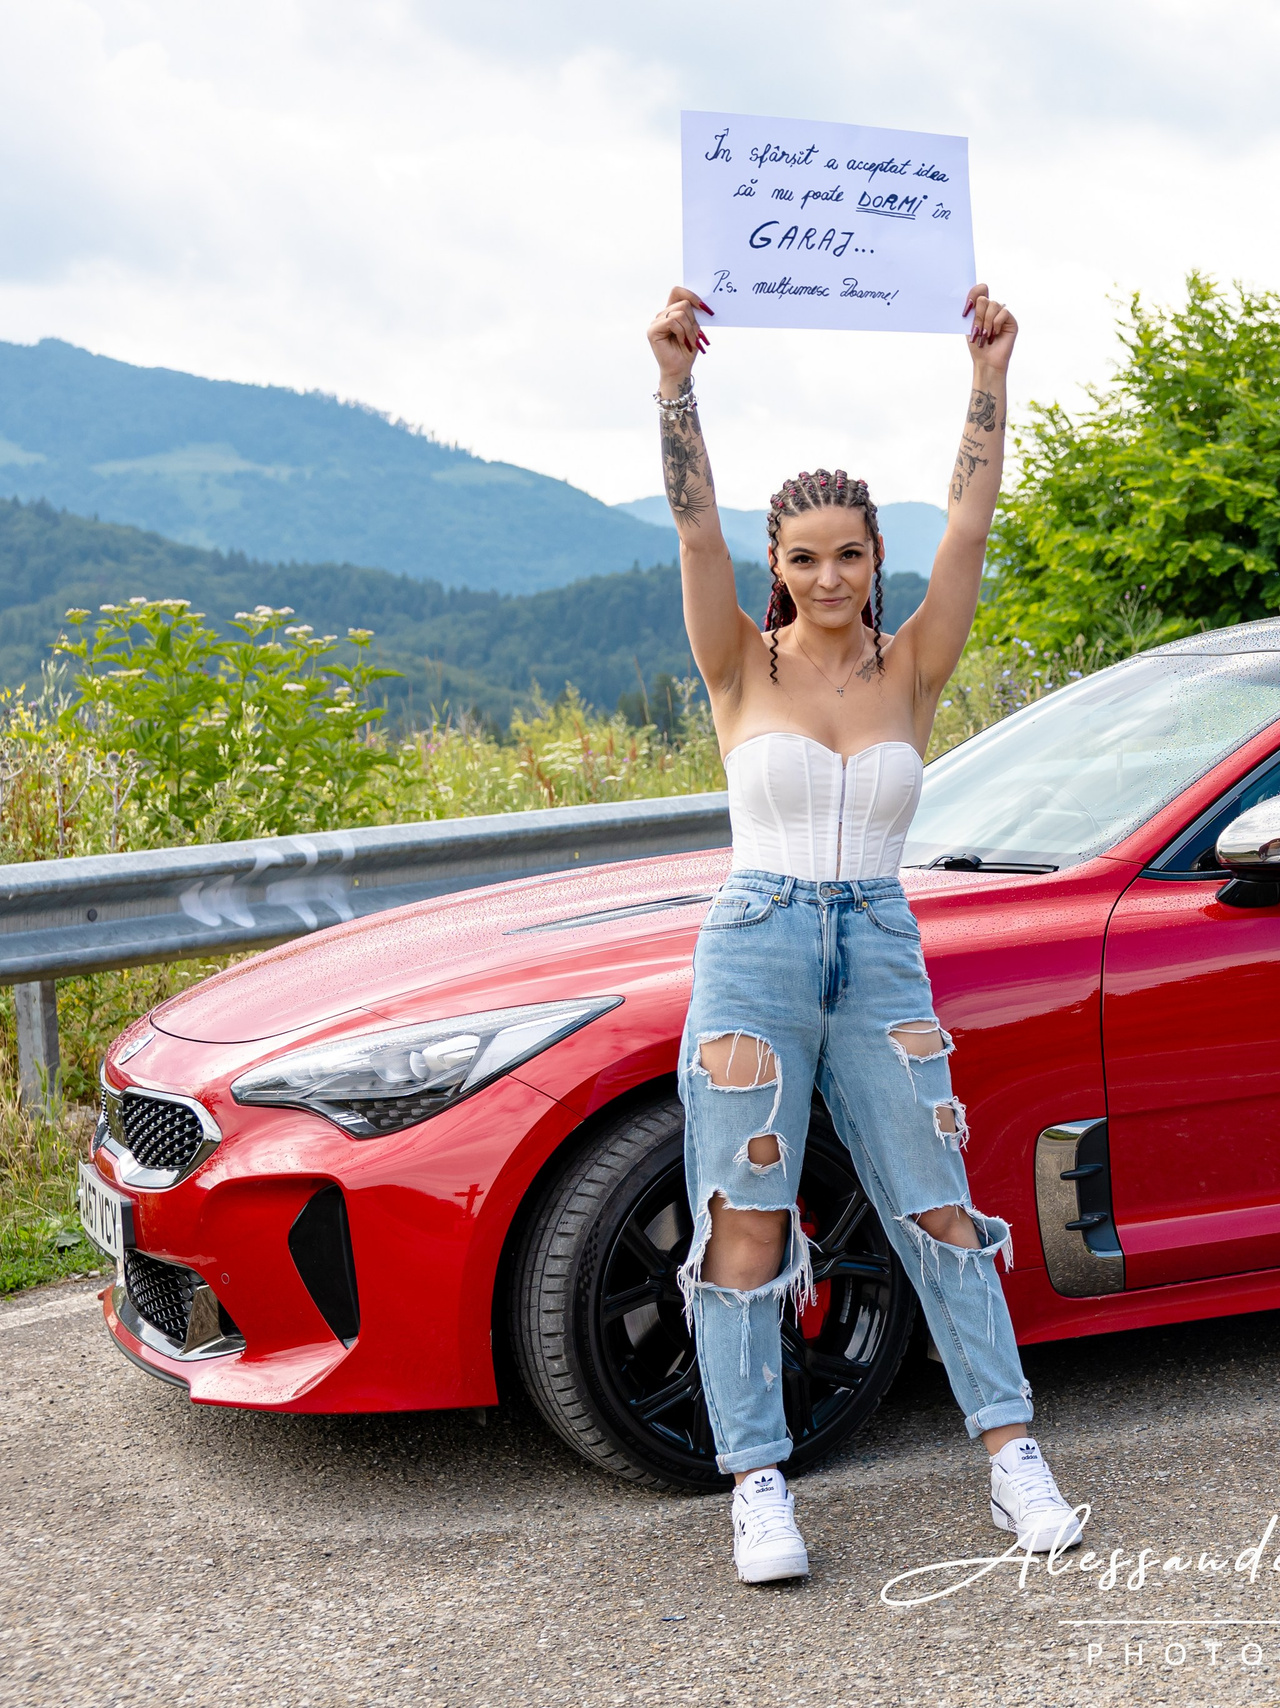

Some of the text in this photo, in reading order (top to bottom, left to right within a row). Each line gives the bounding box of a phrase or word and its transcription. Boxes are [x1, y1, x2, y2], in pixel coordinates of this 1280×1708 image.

[824, 157, 839, 171] a
[846, 158, 912, 183] acceptat
[912, 164, 950, 184] idea
[733, 178, 759, 198] că
[771, 187, 794, 202] nu
[801, 185, 844, 210] poate
[932, 202, 952, 220] în
[749, 220, 875, 257] GARAJ...
[840, 277, 900, 306] Doamne!
[99, 1191, 118, 1250] VCY
[755, 1486, 775, 1494] adidas
